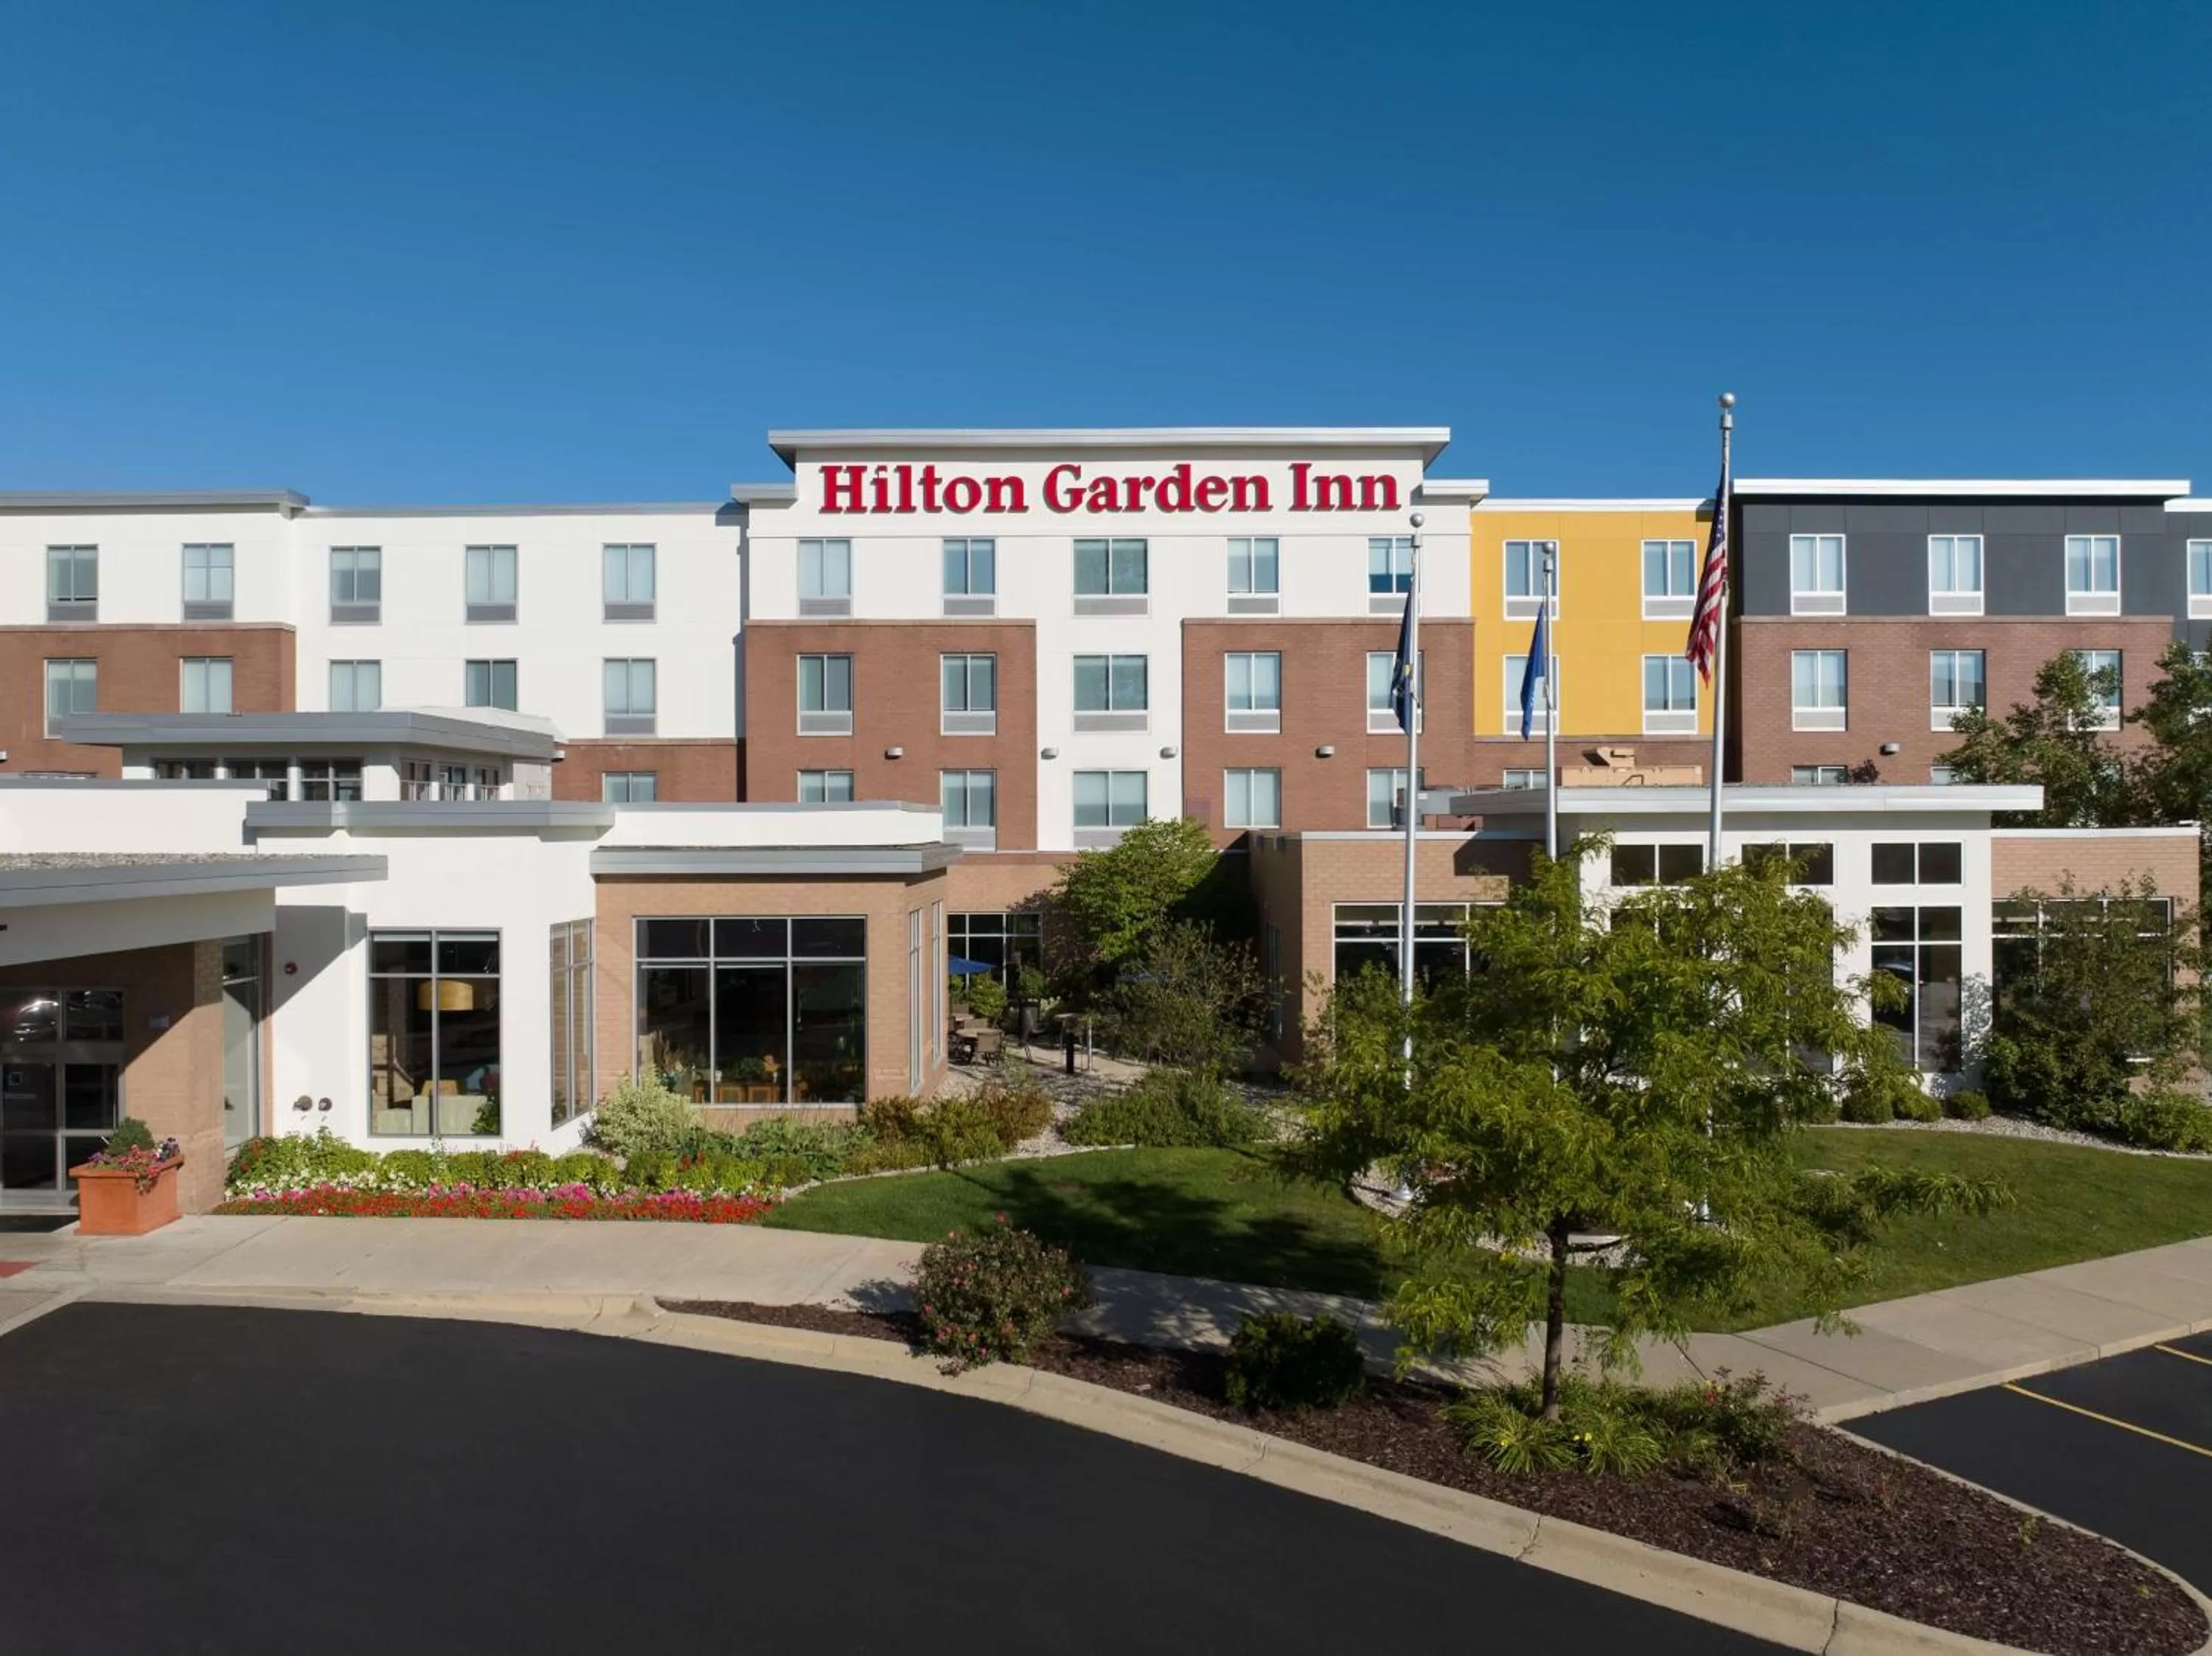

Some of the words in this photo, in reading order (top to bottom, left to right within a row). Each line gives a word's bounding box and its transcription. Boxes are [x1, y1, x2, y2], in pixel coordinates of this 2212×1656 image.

[820, 464, 1028, 513] Hilton
[1043, 463, 1273, 512] Garden
[1289, 462, 1400, 511] Inn
